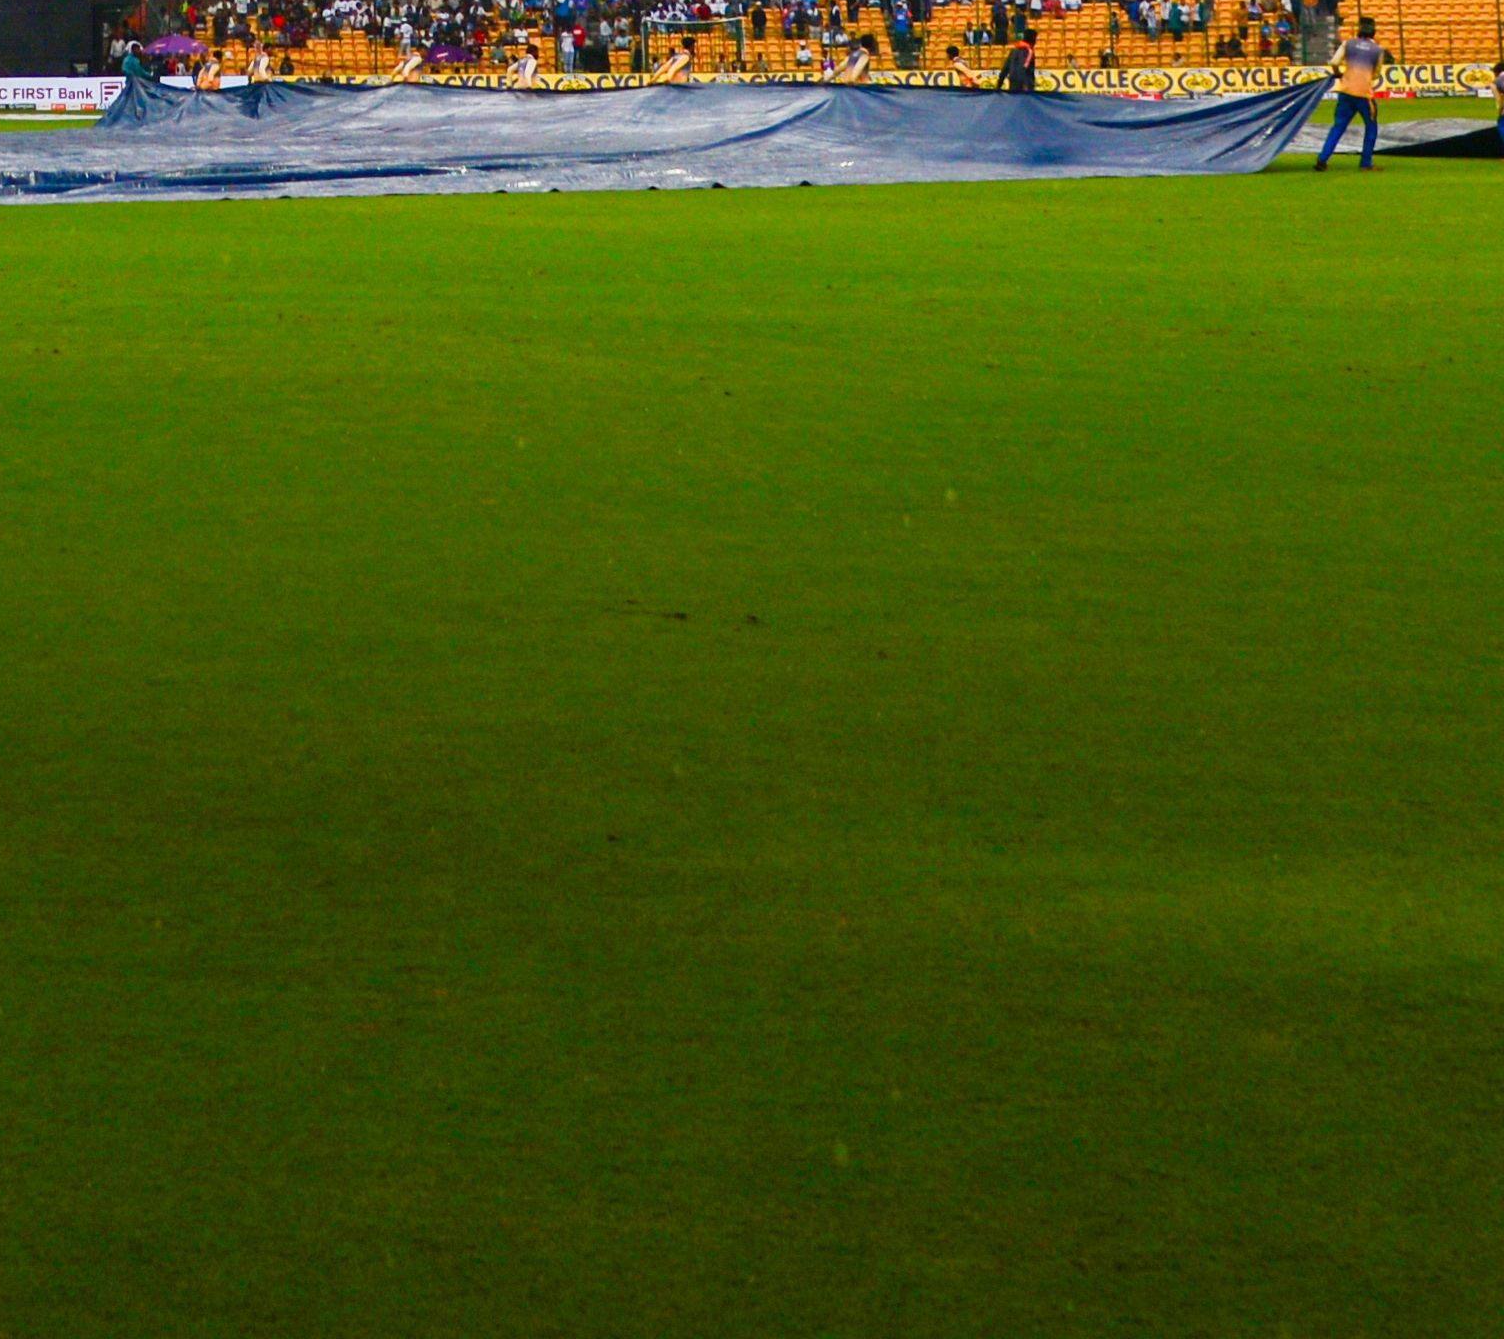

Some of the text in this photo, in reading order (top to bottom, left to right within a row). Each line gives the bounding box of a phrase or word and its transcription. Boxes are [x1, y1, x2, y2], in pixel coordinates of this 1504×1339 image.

[1386, 65, 1454, 84] CYCLE
[13, 87, 54, 100] FIRST
[58, 86, 93, 99] Bank
